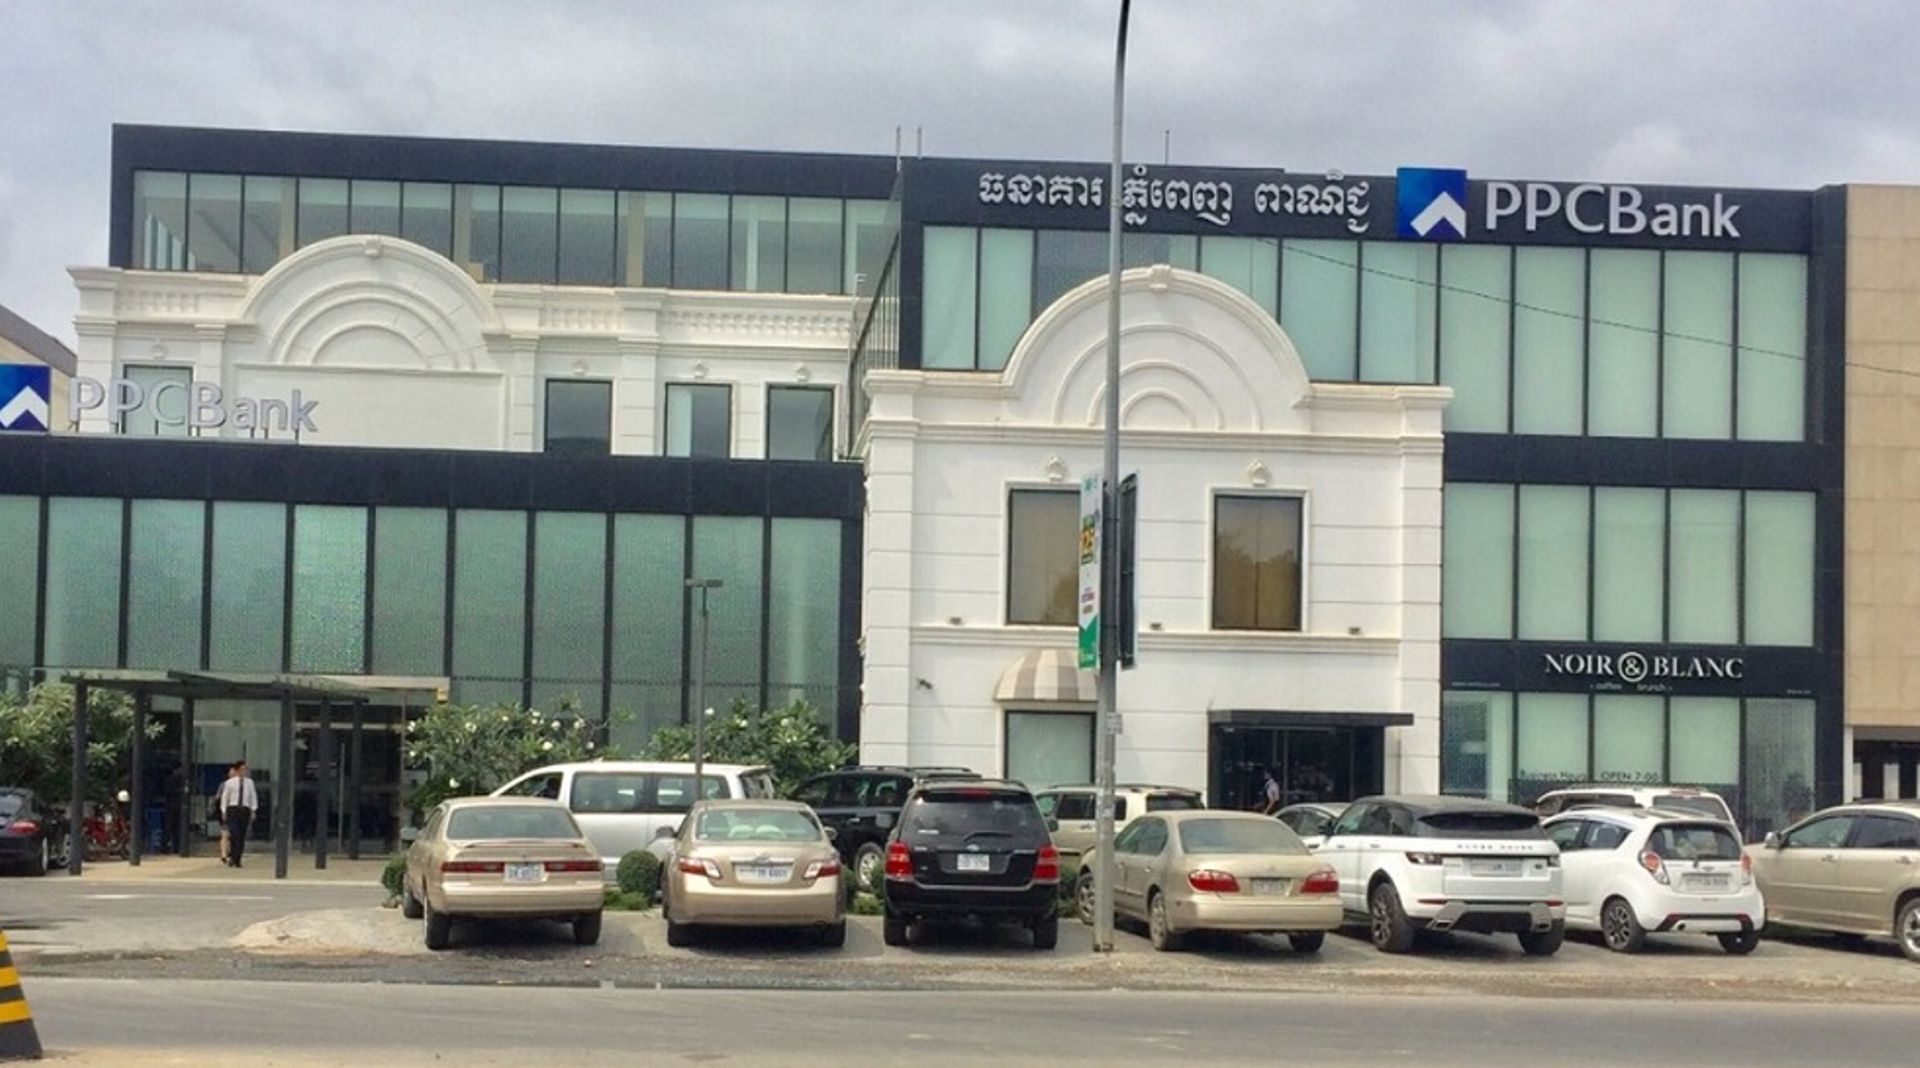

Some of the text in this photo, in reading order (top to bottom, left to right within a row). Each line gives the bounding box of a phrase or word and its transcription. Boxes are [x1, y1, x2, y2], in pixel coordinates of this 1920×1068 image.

[979, 172, 1103, 207] ធនាគារ
[1123, 164, 1233, 226] ភ្នំពេញ
[1486, 181, 1741, 238] PPCBank
[69, 377, 319, 433] PPCBank
[1545, 653, 1614, 675] NOIR
[1653, 655, 1743, 678] BLANC
